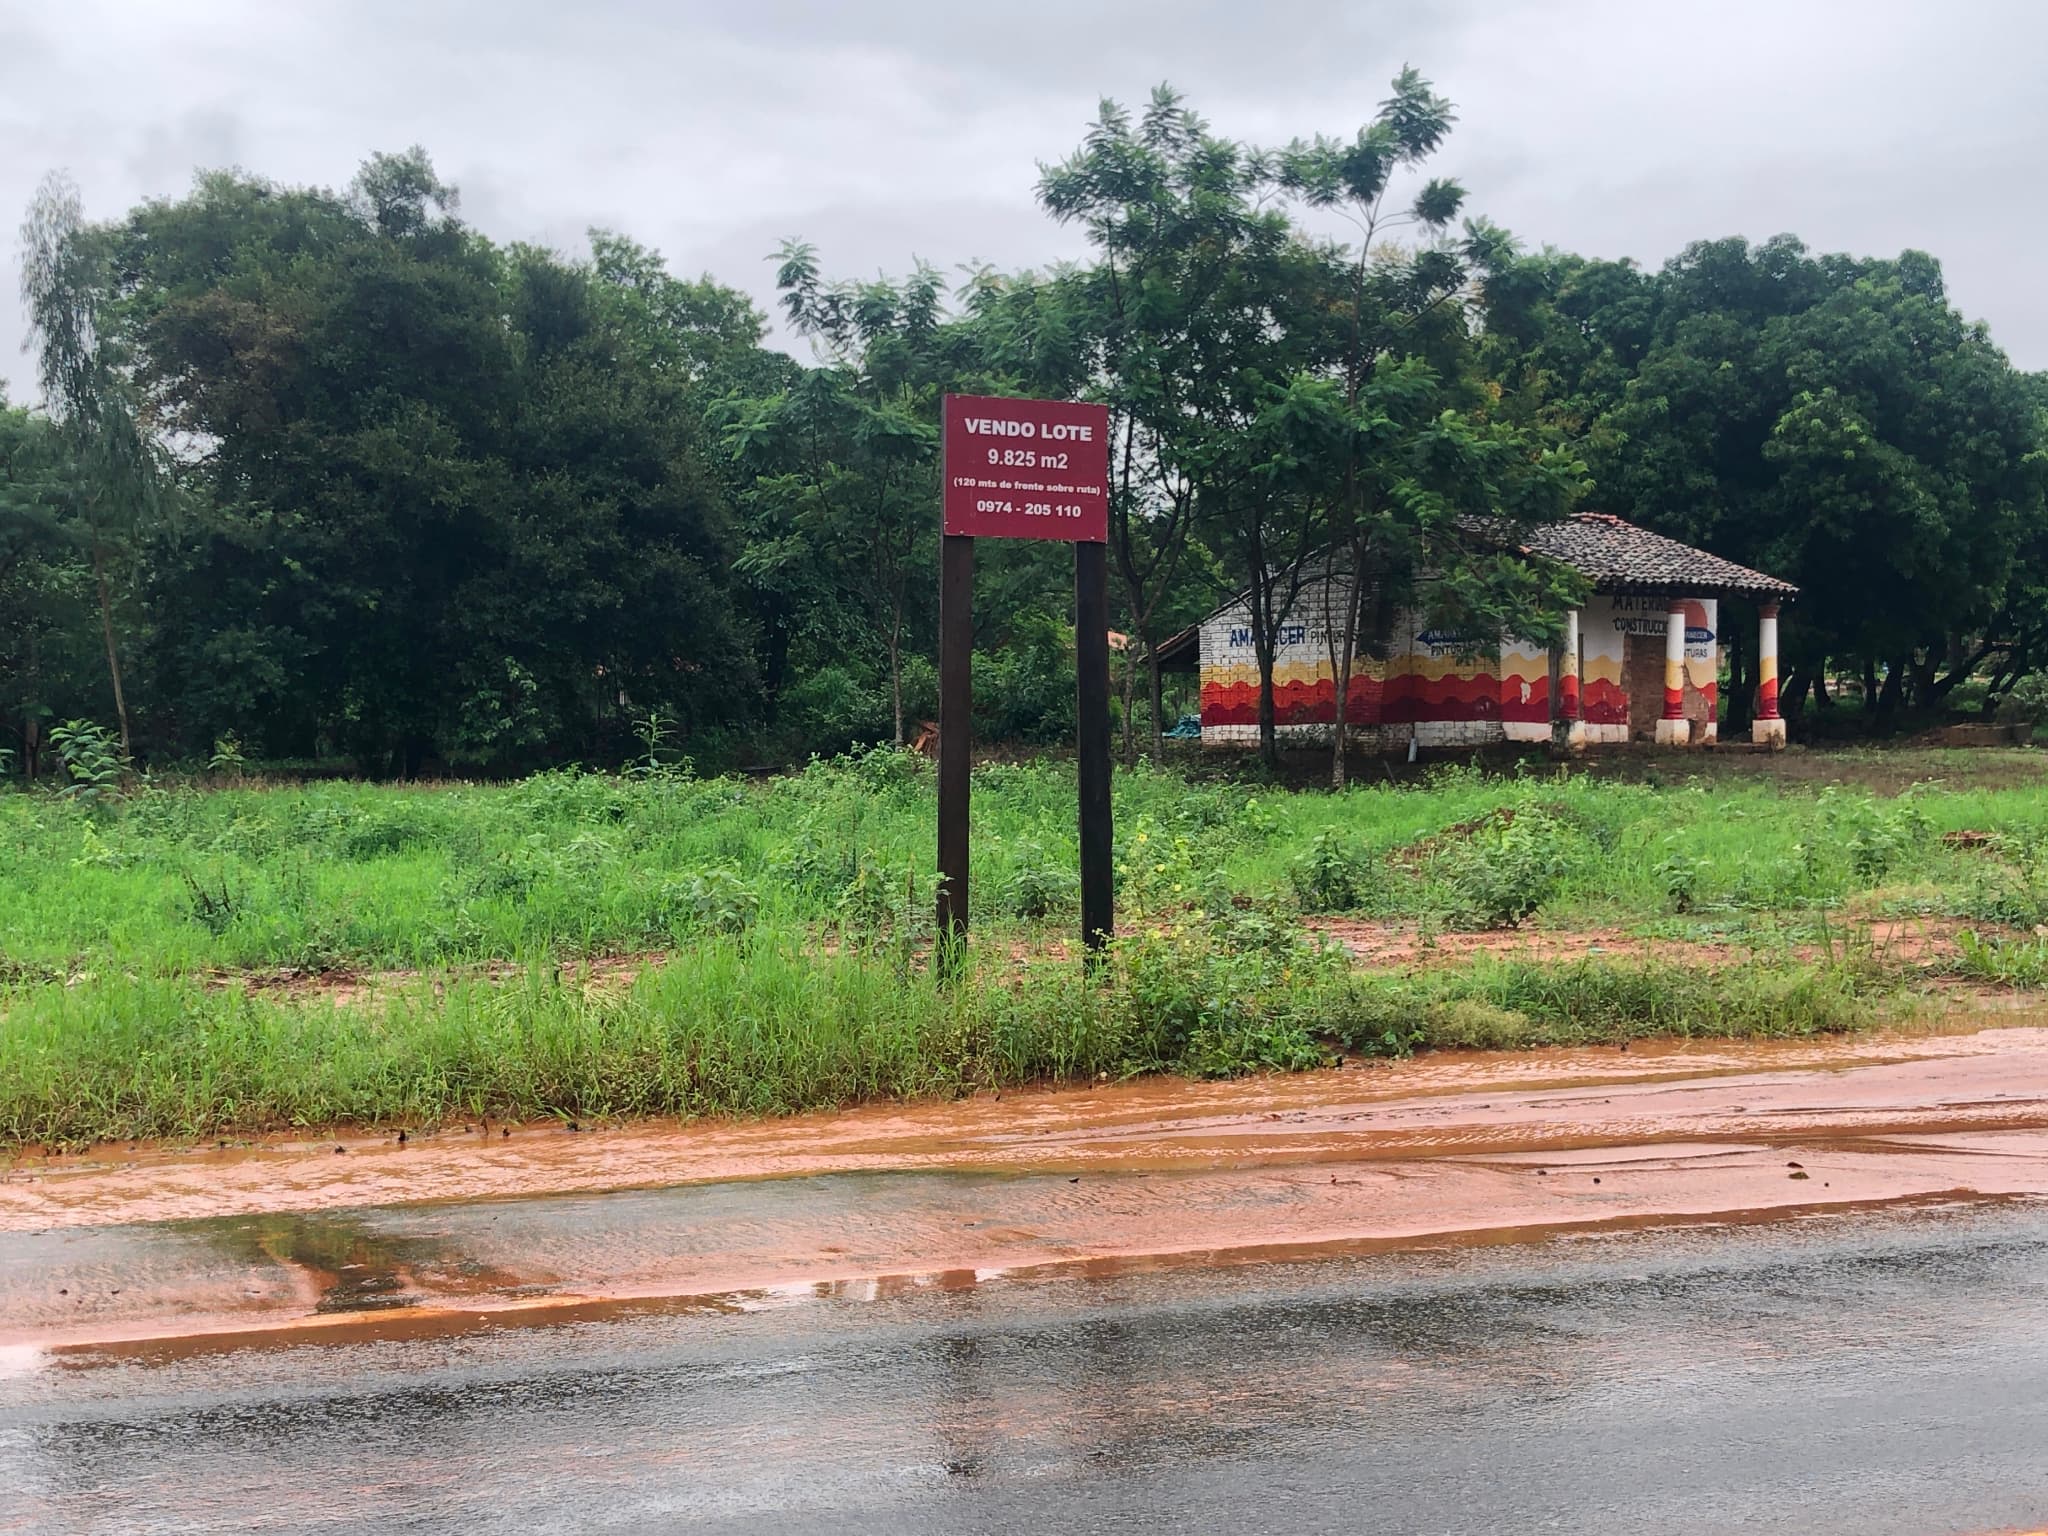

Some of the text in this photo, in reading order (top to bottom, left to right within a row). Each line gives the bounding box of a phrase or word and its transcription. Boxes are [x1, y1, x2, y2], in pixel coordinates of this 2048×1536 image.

[964, 417, 1092, 442] VENDO LOTE
[987, 448, 1069, 469] 9.825 m2
[953, 477, 1101, 496] (120 mts de frente sobre ruta)
[976, 500, 1013, 513] 0974
[1024, 503, 1051, 516] 205
[1055, 505, 1082, 517] 110
